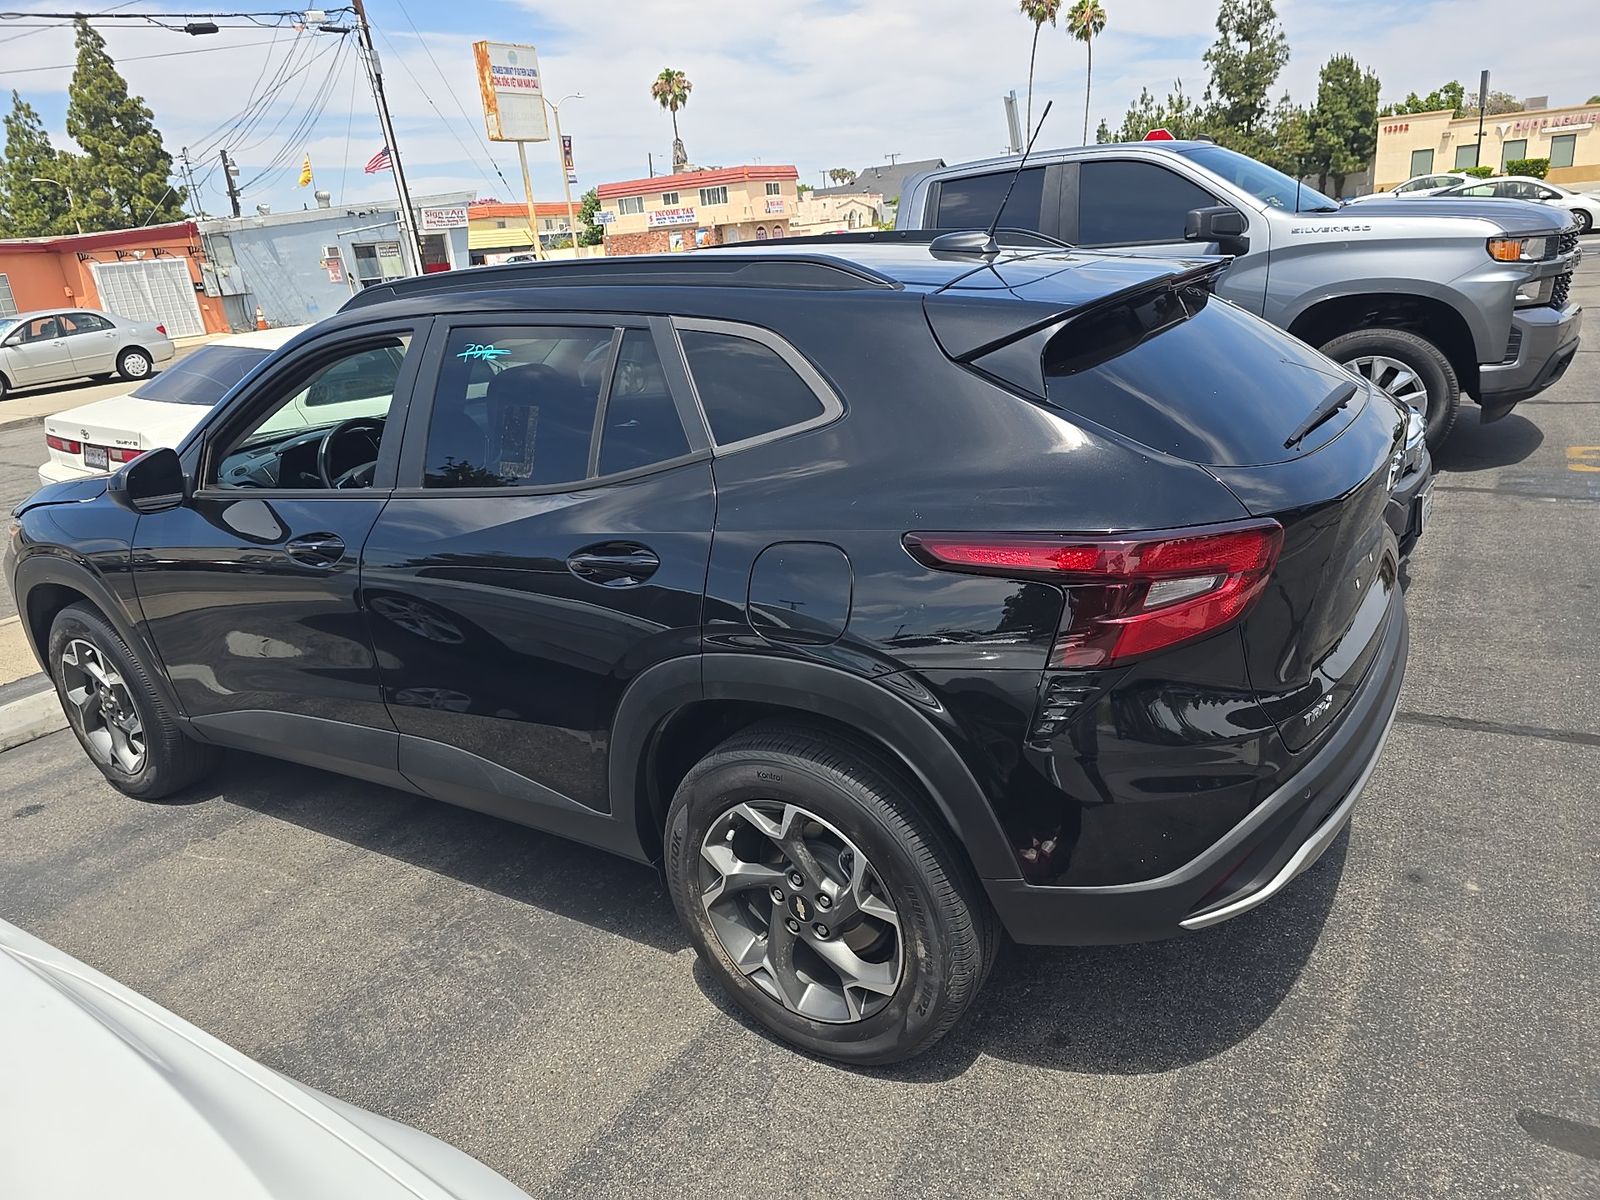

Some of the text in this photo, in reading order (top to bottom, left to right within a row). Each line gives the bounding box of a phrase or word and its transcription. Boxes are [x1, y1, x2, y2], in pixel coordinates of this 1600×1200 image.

[424, 210, 443, 218] Sign
[655, 209, 680, 217] INCOME
[1291, 225, 1372, 234] SILVERADO
